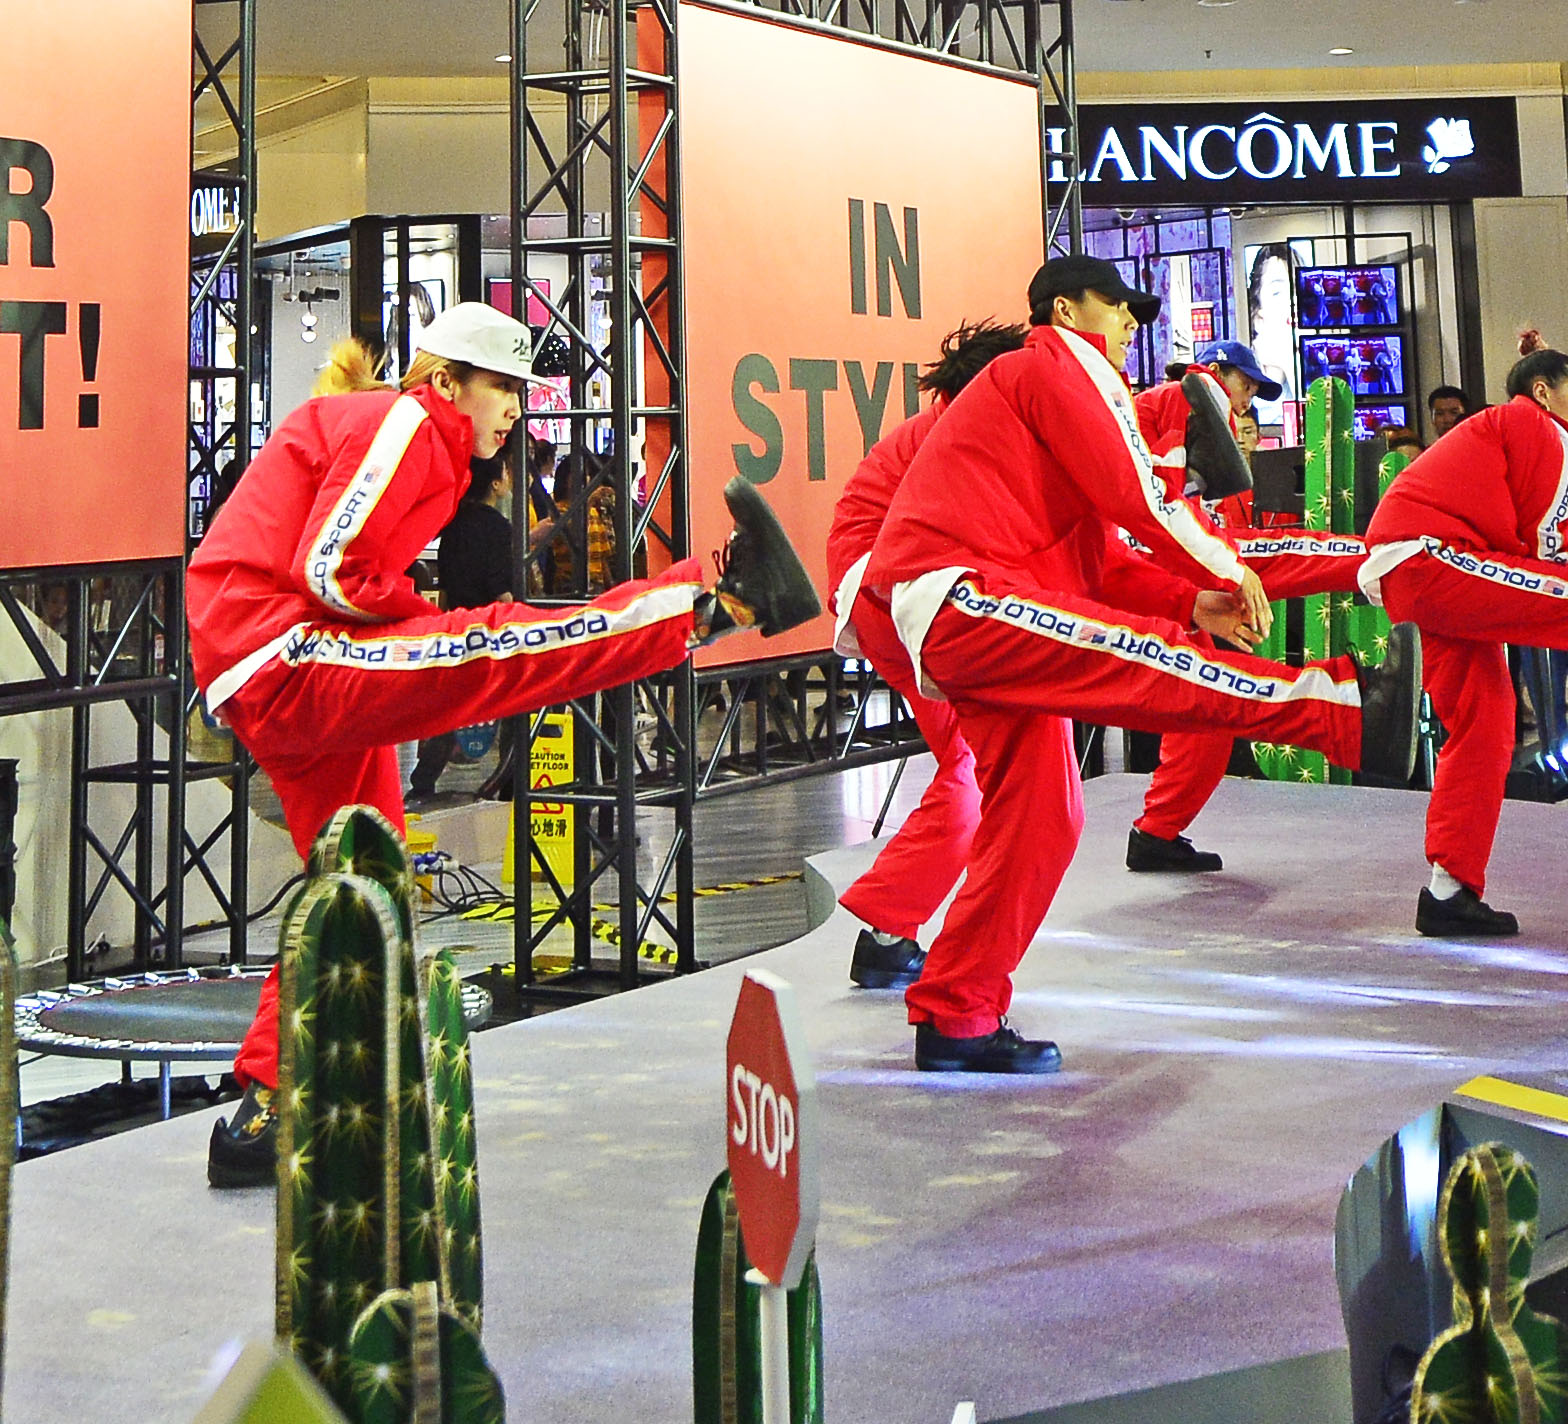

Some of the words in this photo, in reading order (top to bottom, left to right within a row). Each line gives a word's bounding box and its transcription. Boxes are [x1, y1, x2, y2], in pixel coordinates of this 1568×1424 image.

[1046, 111, 1402, 182] LANCÔME
[848, 196, 922, 320] IN
[320, 487, 368, 557] SPORT
[1481, 563, 1541, 590] POLO
[524, 613, 609, 647] POLO
[1004, 603, 1076, 637] POLO
[1110, 632, 1194, 672] SPORT
[1198, 662, 1276, 698] POLO
[542, 761, 569, 770] FLOOR
[732, 1063, 795, 1179] STOP
